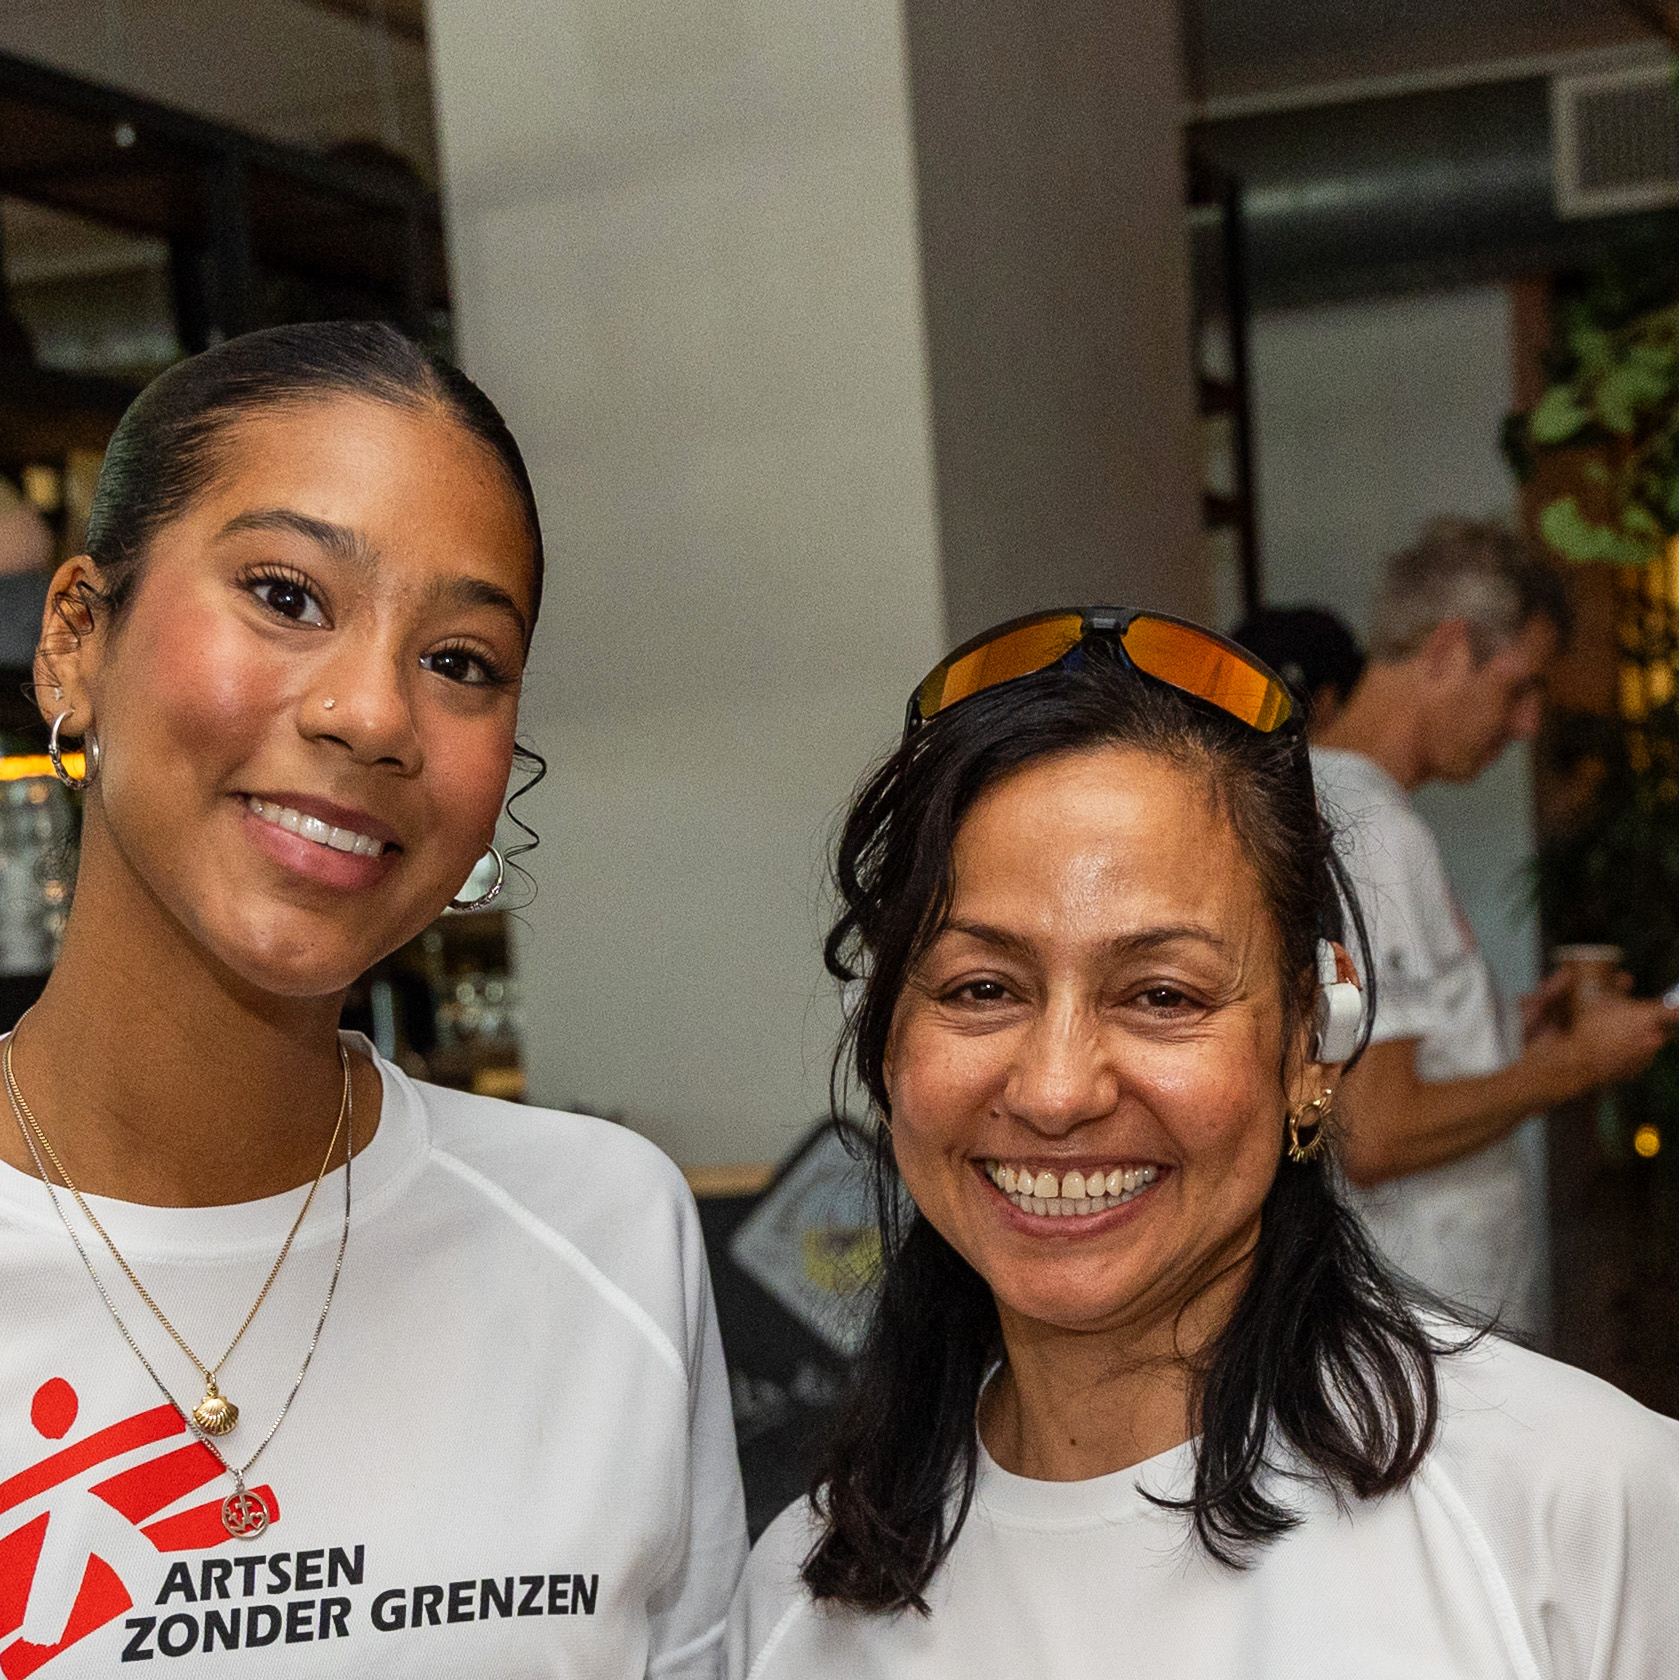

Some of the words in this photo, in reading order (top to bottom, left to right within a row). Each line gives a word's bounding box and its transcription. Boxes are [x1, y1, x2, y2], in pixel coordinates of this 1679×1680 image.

[155, 1545, 365, 1605] ARTSEN
[121, 1597, 351, 1662] ZONDER
[370, 1574, 599, 1632] GRENZEN
